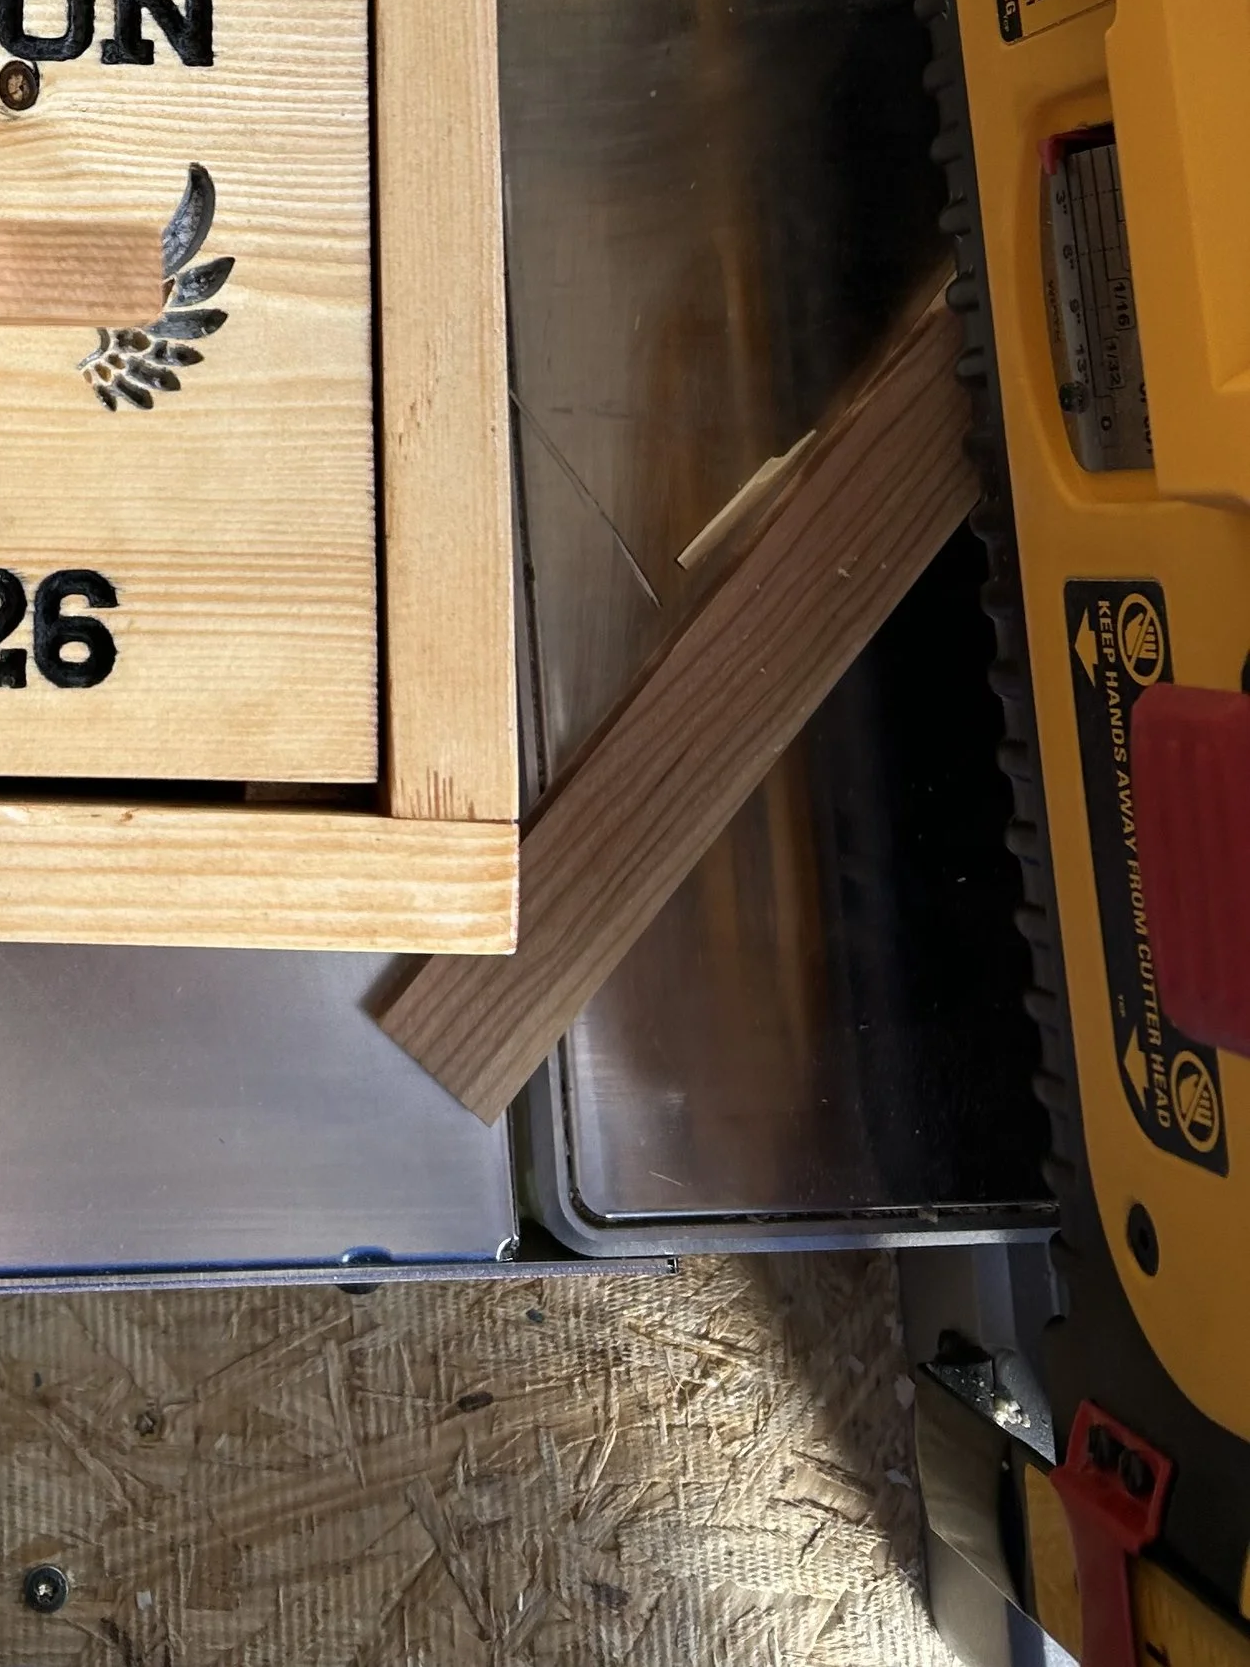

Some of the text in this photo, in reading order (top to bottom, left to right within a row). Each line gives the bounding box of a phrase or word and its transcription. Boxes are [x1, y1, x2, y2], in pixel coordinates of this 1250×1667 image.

[1114, 281, 1130, 326] 1/16
[1097, 598, 1171, 1129] KEEP HANDS AWAY FROM CUTTER HEAD
